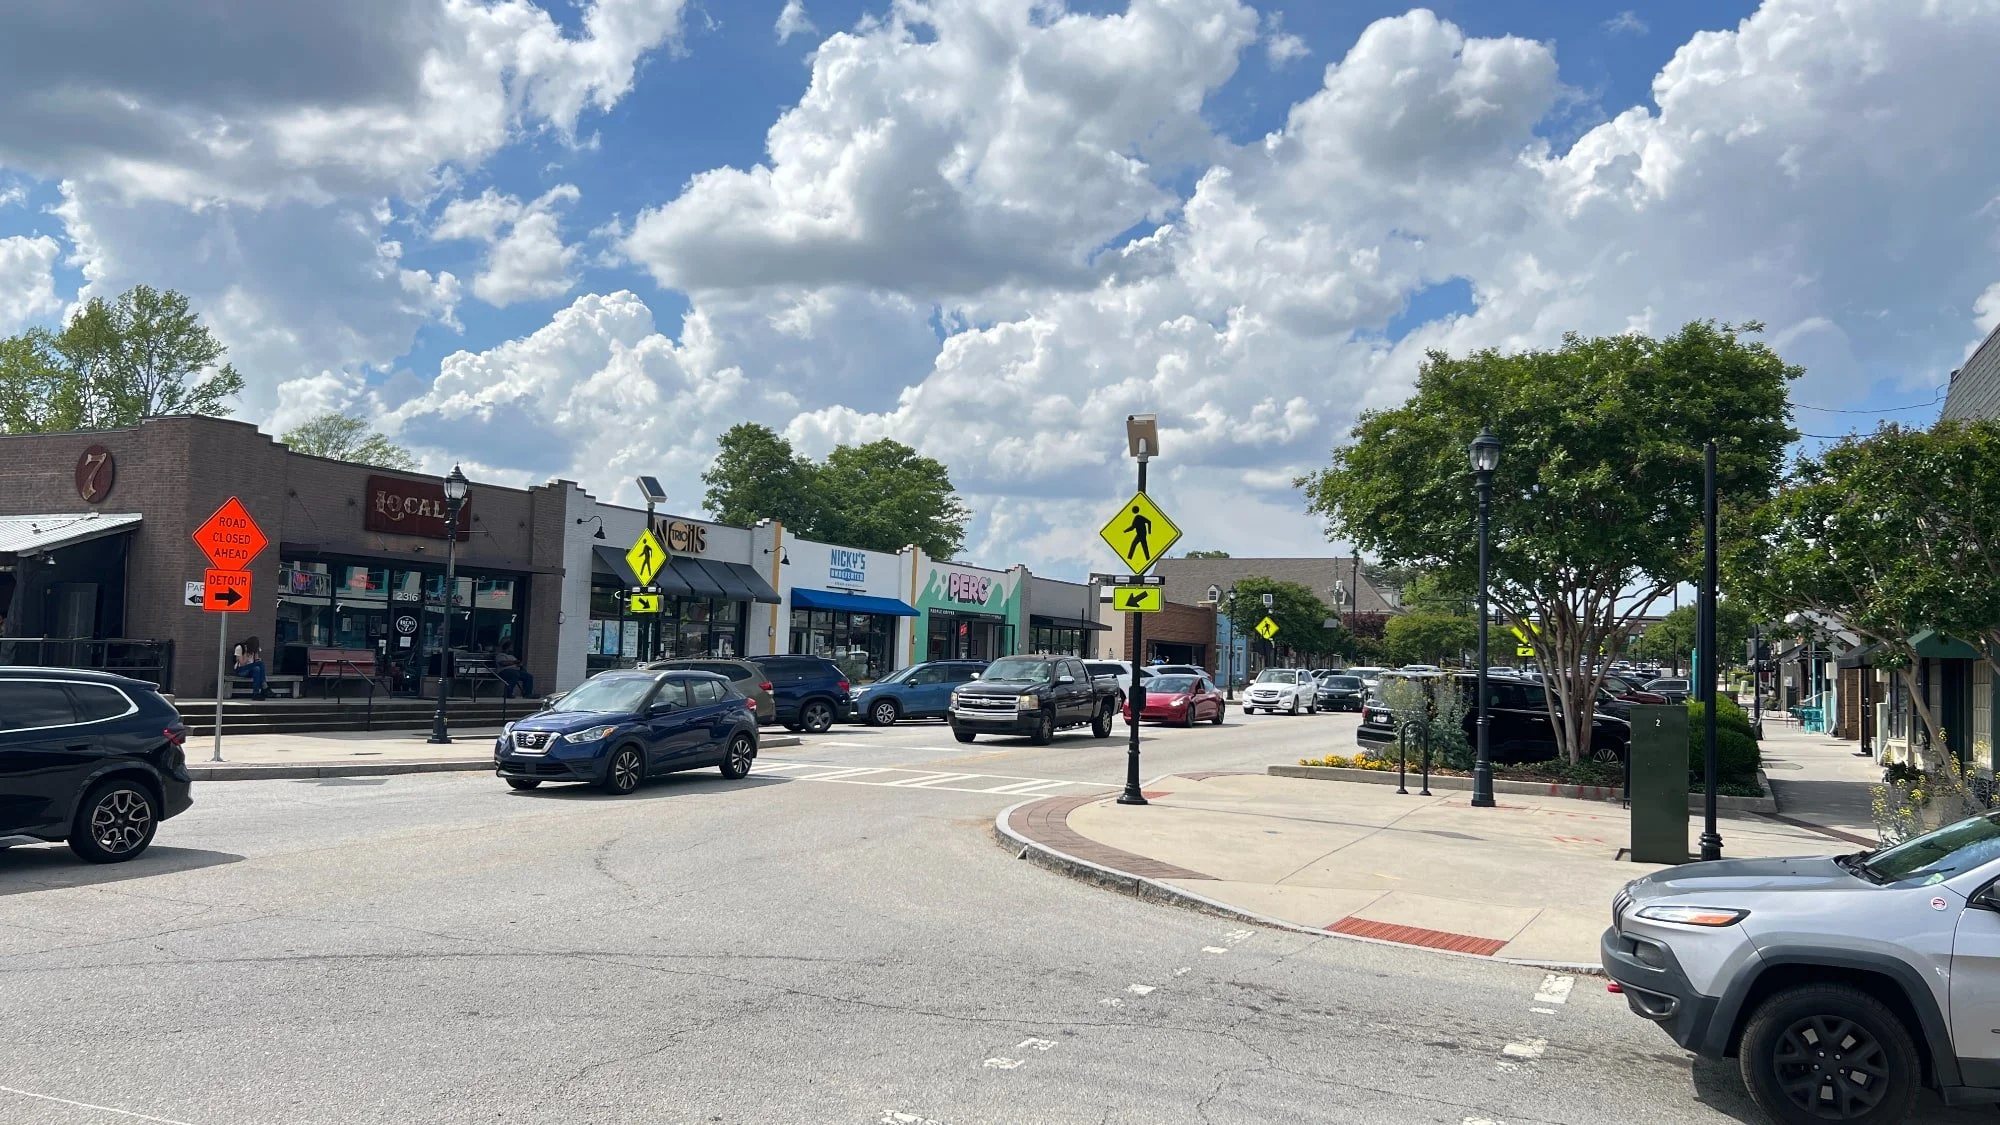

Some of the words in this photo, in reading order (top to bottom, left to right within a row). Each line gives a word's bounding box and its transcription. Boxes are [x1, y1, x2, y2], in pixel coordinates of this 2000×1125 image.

[82, 452, 107, 500] 7
[376, 490, 445, 521] LOCAL
[219, 517, 246, 528] ROAD
[213, 532, 251, 544] CLOSED
[214, 548, 248, 559] AHEAD
[831, 548, 866, 569] NICKY'S
[209, 575, 247, 586] DETOUR
[948, 572, 989, 605] PERC
[396, 592, 419, 602] 2316
[336, 602, 343, 612] 7
[464, 611, 471, 620] 7
[511, 614, 517, 623] 7
[1655, 718, 1661, 727] 2
